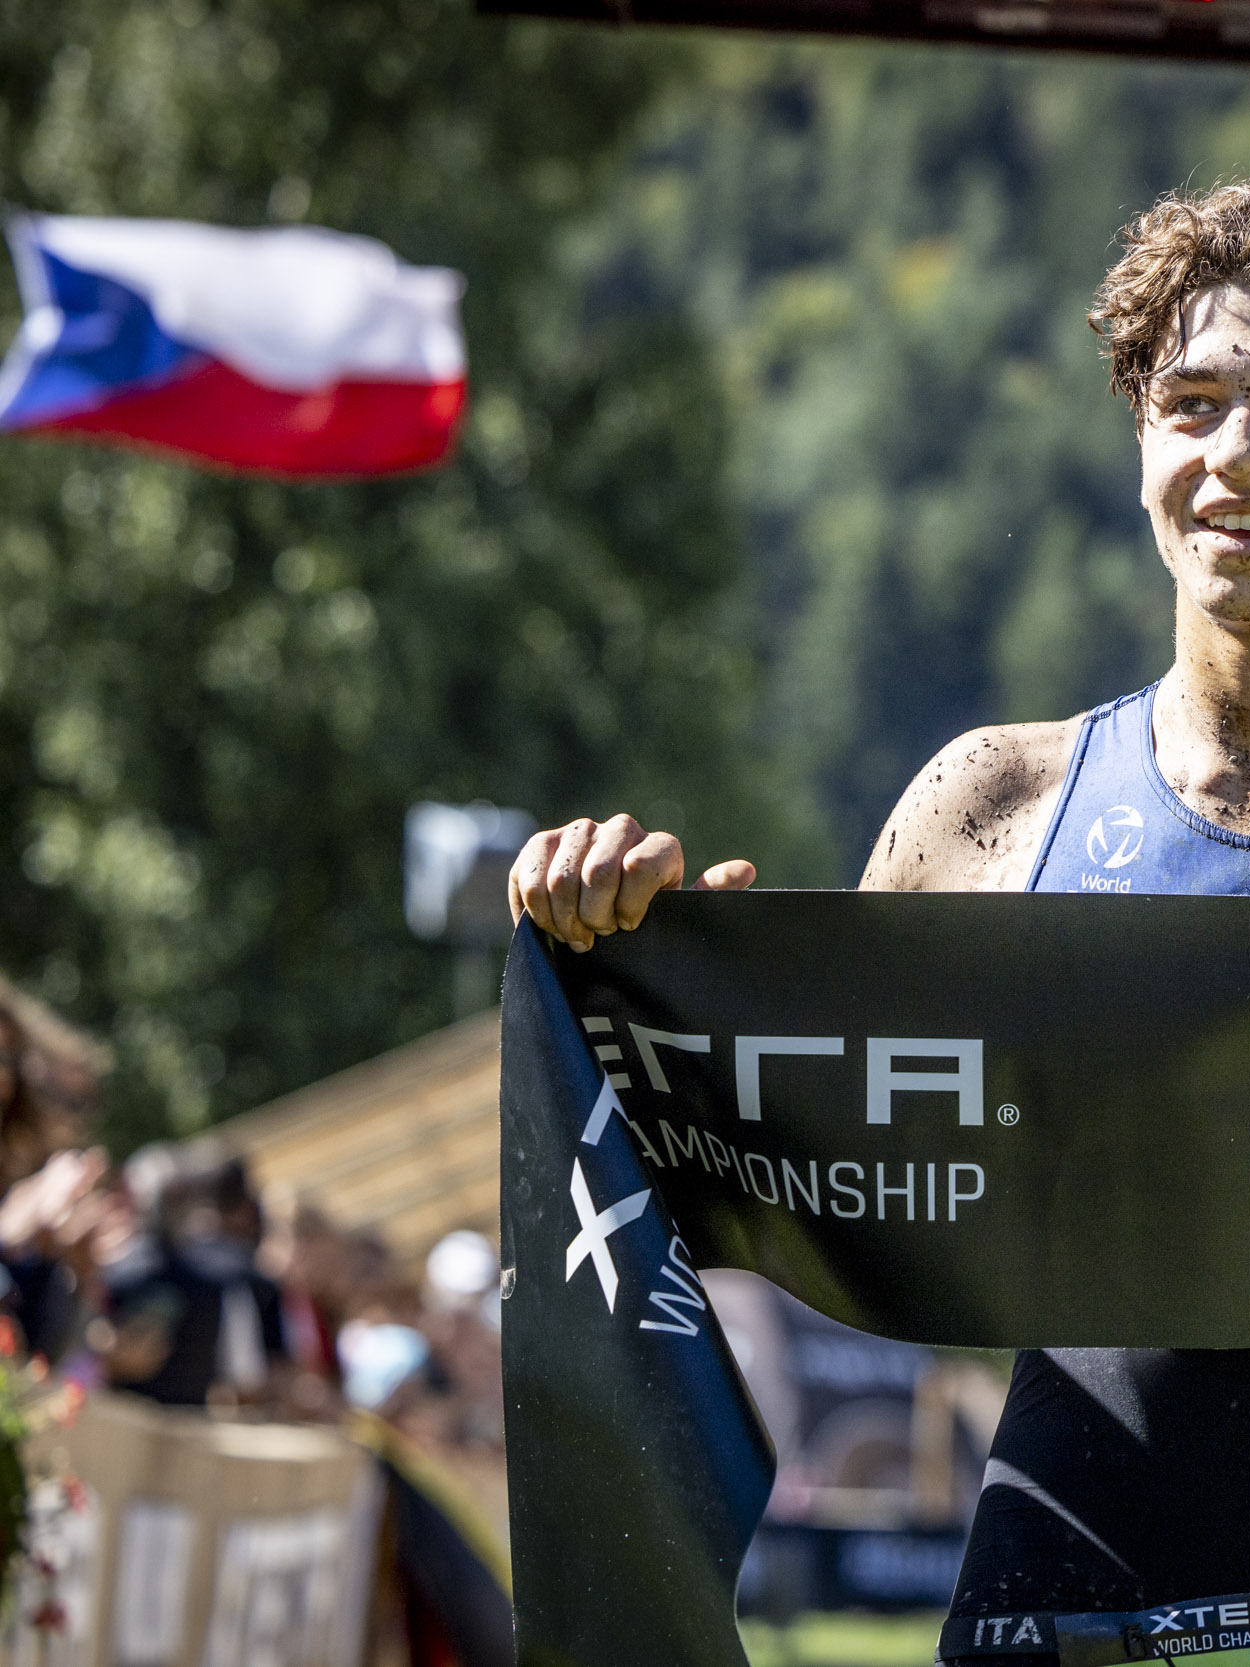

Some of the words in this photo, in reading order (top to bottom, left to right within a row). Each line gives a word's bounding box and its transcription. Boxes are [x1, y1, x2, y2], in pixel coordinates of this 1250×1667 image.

[1081, 872, 1132, 893] World
[974, 1616, 1043, 1646] ITA
[1153, 1634, 1214, 1656] WORLD
